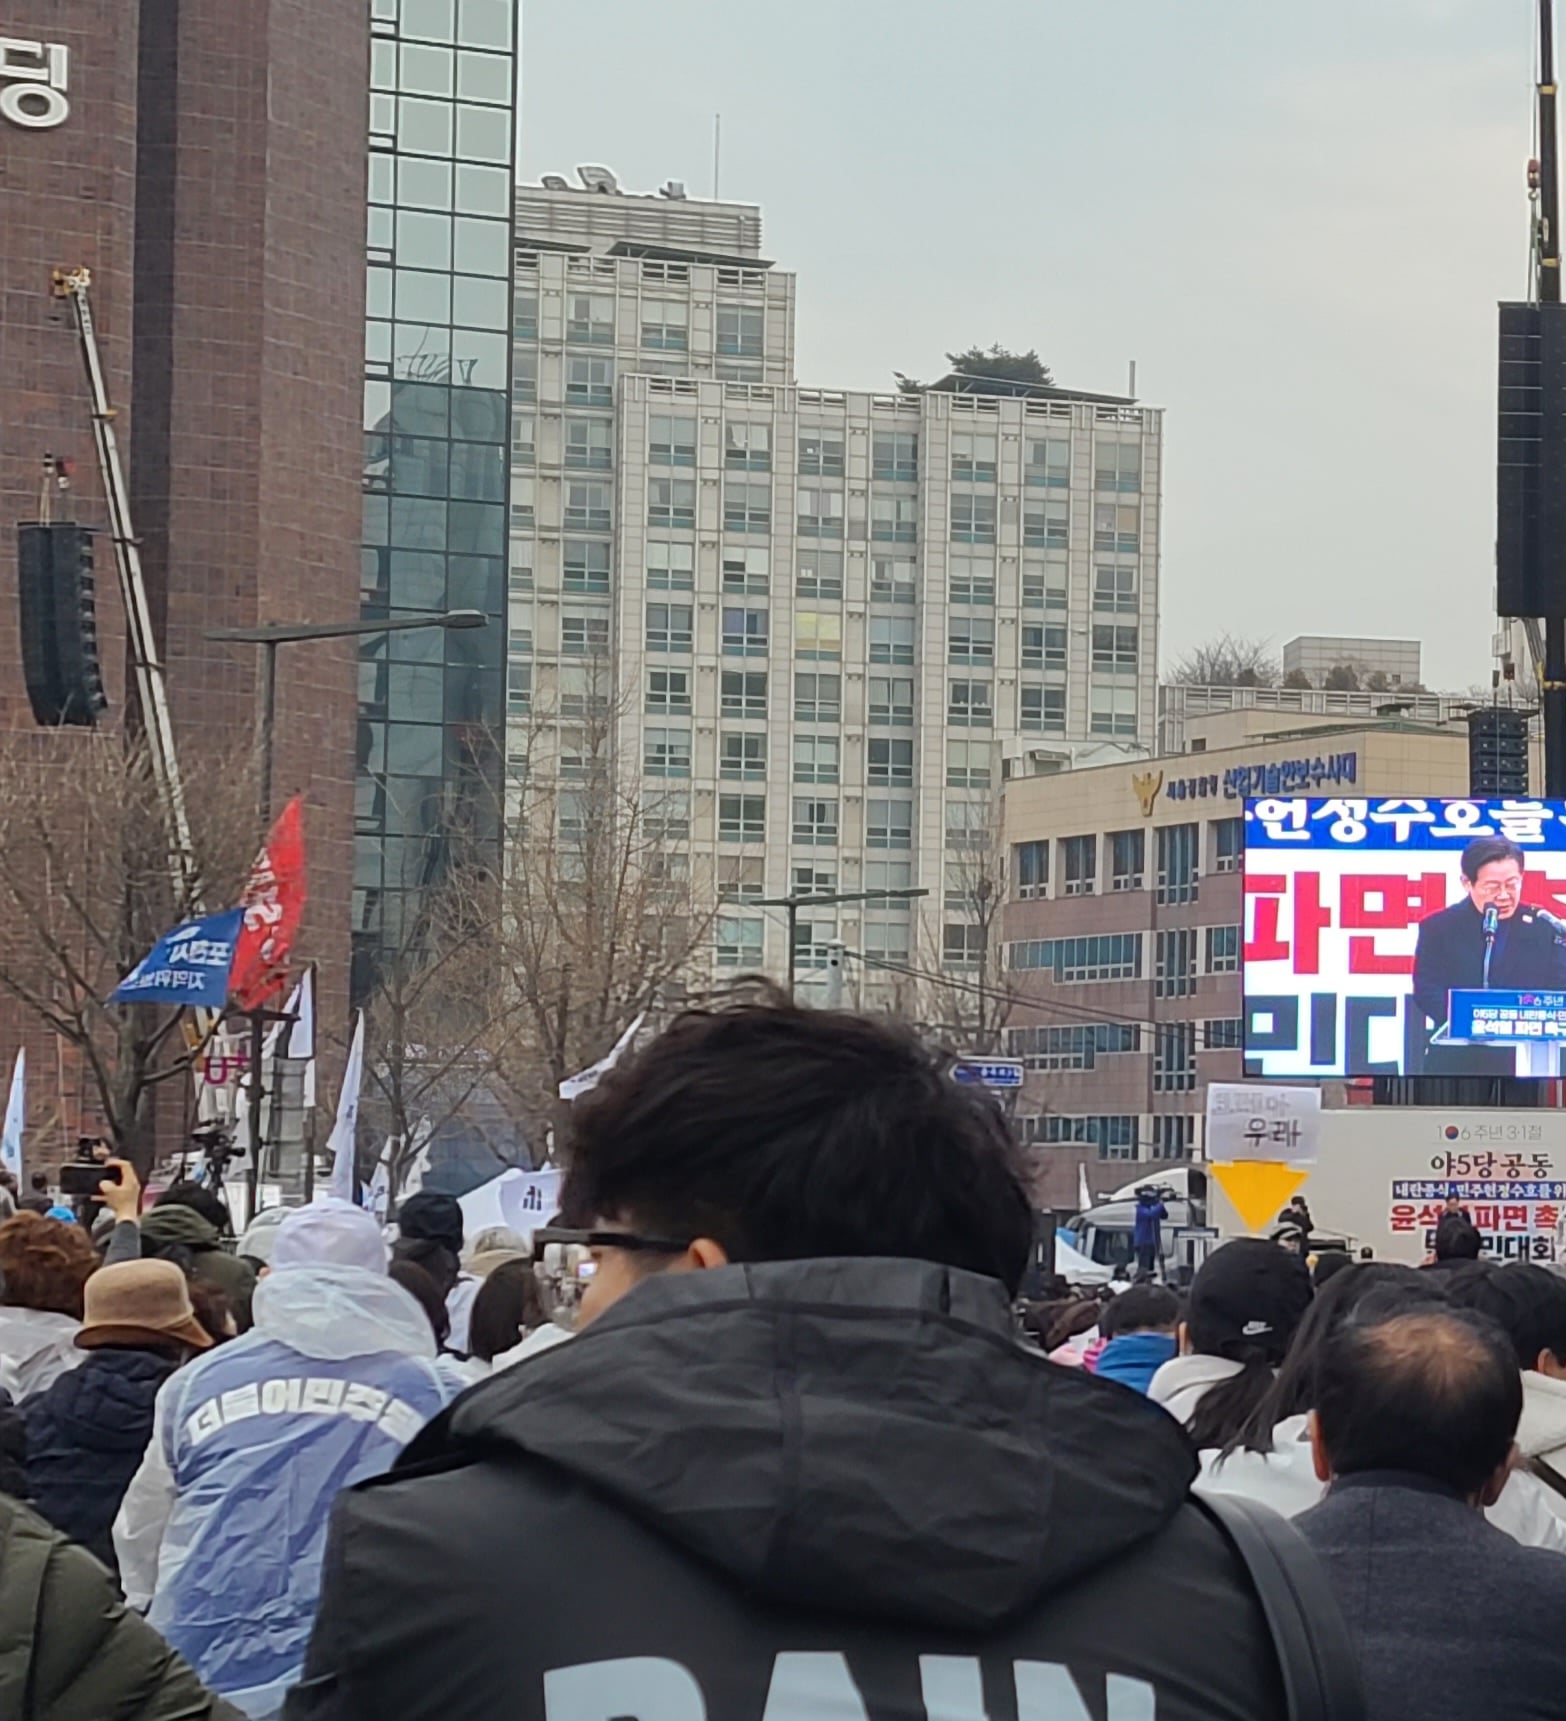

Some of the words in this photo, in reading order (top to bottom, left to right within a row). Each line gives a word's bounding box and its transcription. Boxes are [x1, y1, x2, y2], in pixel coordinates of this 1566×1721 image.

[1431, 1151, 1498, 1179] 야5당
[1500, 1152, 1554, 1179] 공동
[1391, 1204, 1468, 1232] 윤석
[1474, 1204, 1529, 1232] 파면
